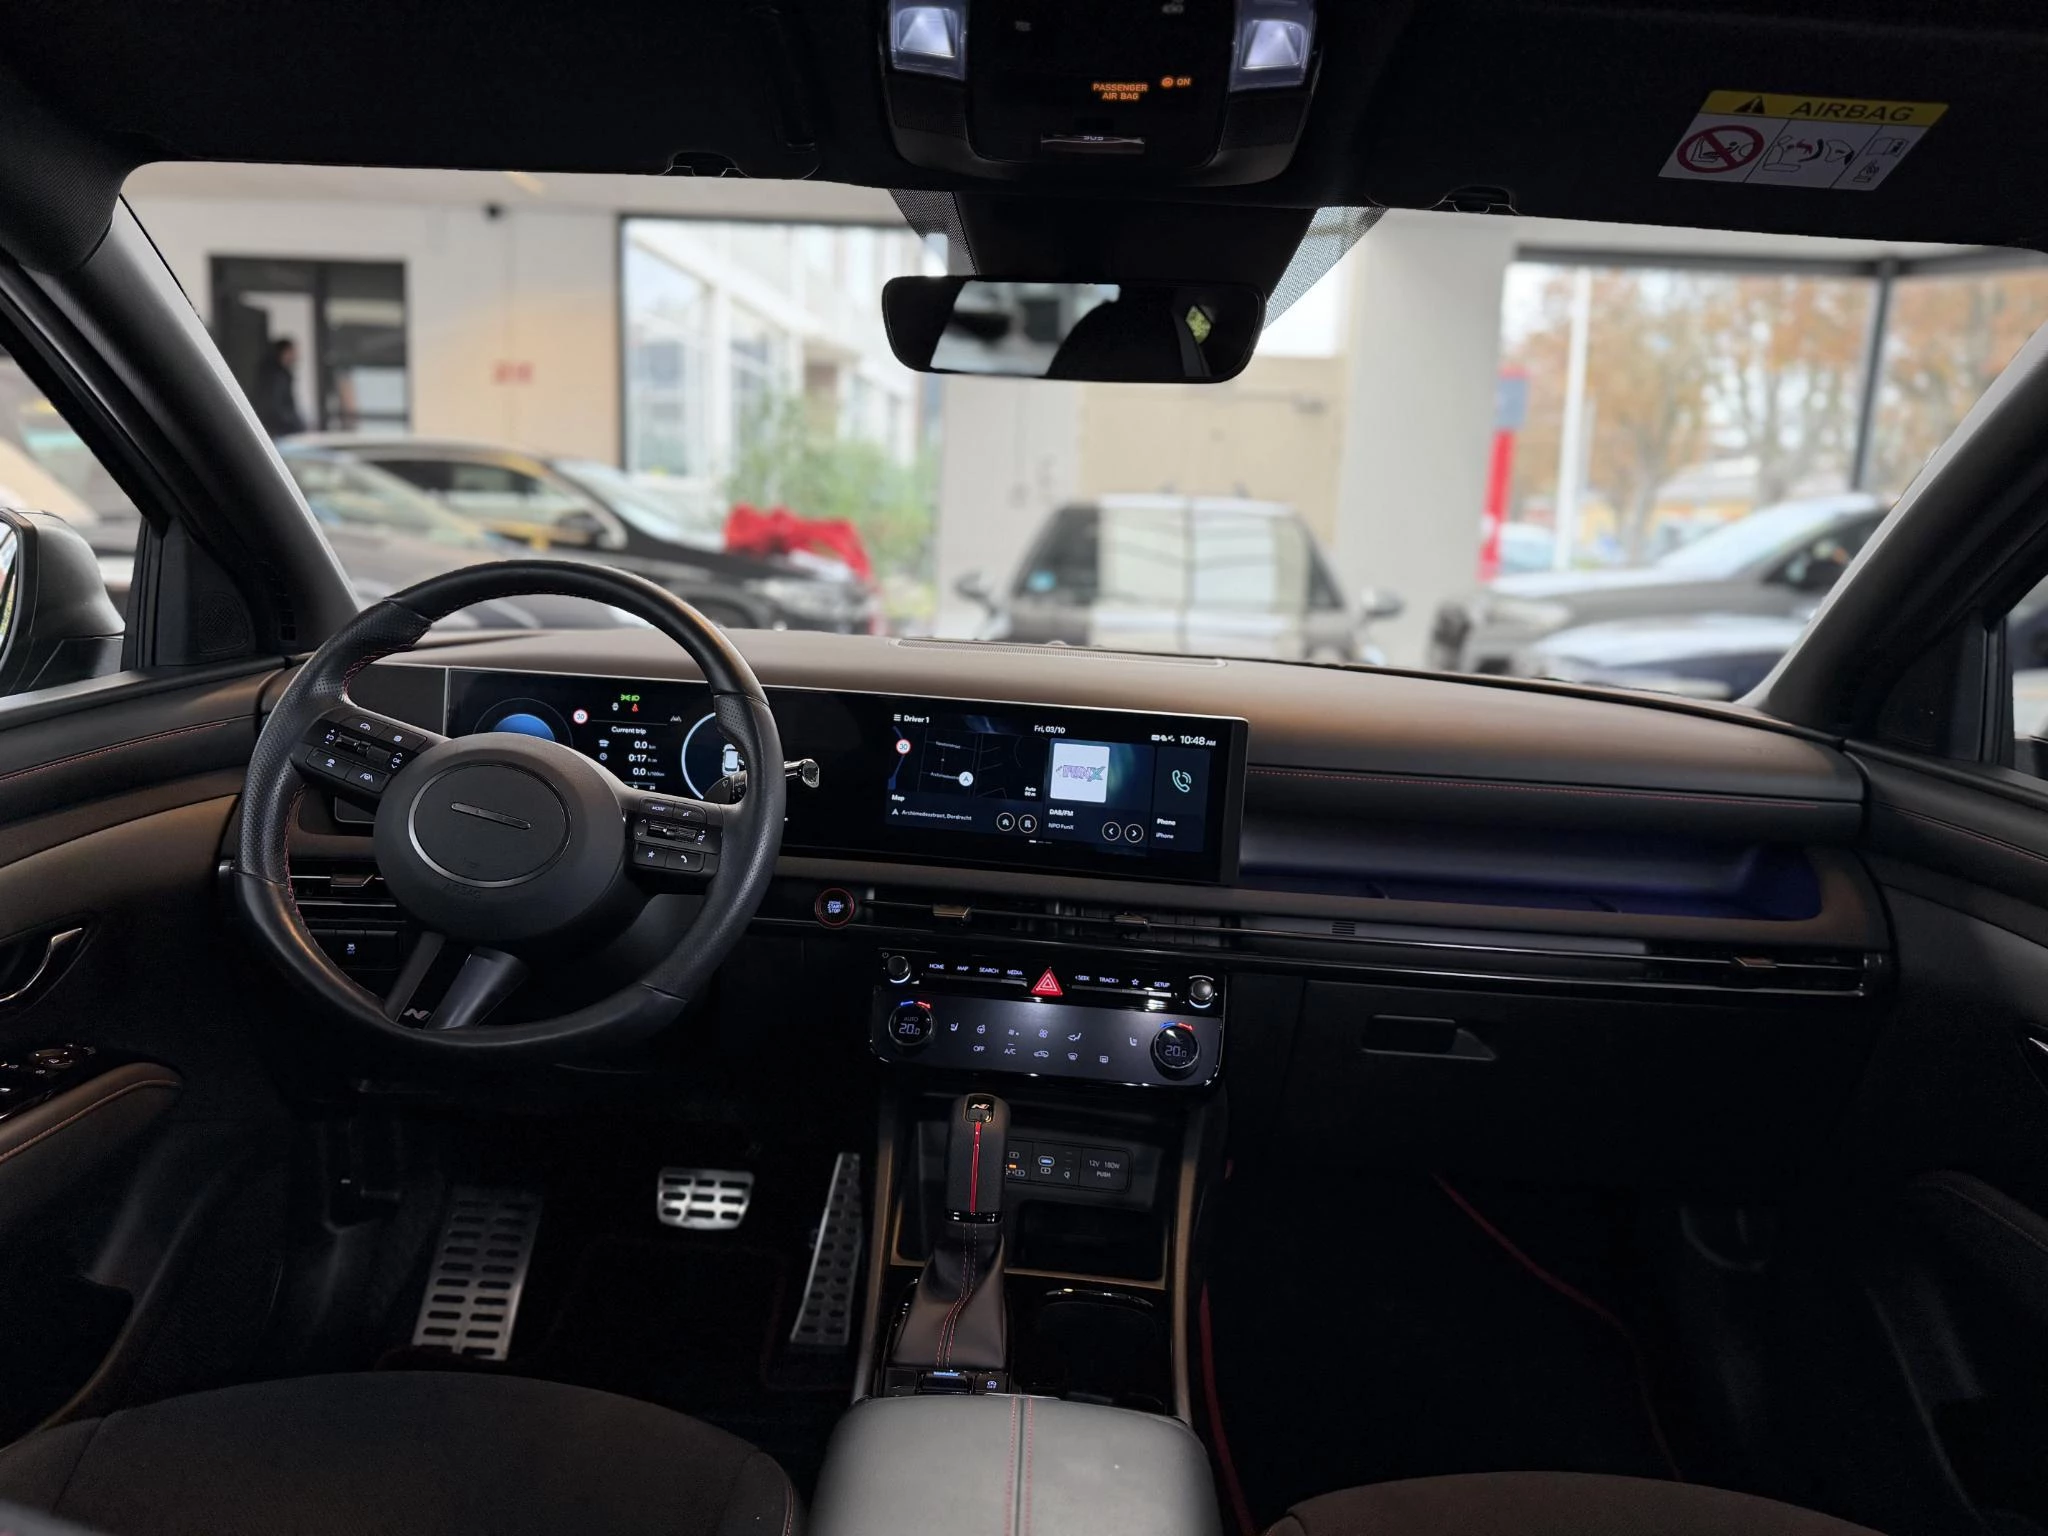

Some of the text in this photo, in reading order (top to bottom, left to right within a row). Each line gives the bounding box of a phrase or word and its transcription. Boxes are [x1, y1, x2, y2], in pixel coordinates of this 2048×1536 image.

[1176, 77, 1191, 87] ON
[1093, 84, 1148, 92] PASSENGER
[1789, 101, 1916, 122] AIRBAG
[903, 714, 925, 724] Driver
[611, 726, 635, 734] Current
[1034, 724, 1066, 735] Fri, 03/10
[634, 741, 648, 749] 0.0
[1179, 734, 1217, 747] 10:48 AM
[628, 753, 647, 762] 0:17
[632, 767, 647, 776] 0.0
[891, 794, 906, 802] Map
[1049, 808, 1074, 817] DAB/FM
[1156, 817, 1176, 826] Phone
[1155, 832, 1175, 840] iPhone
[978, 966, 999, 974] SEARCH
[1004, 1047, 1017, 1055] A/C
[1089, 1159, 1100, 1168] 12V
[1096, 1170, 1111, 1178] PUSH
